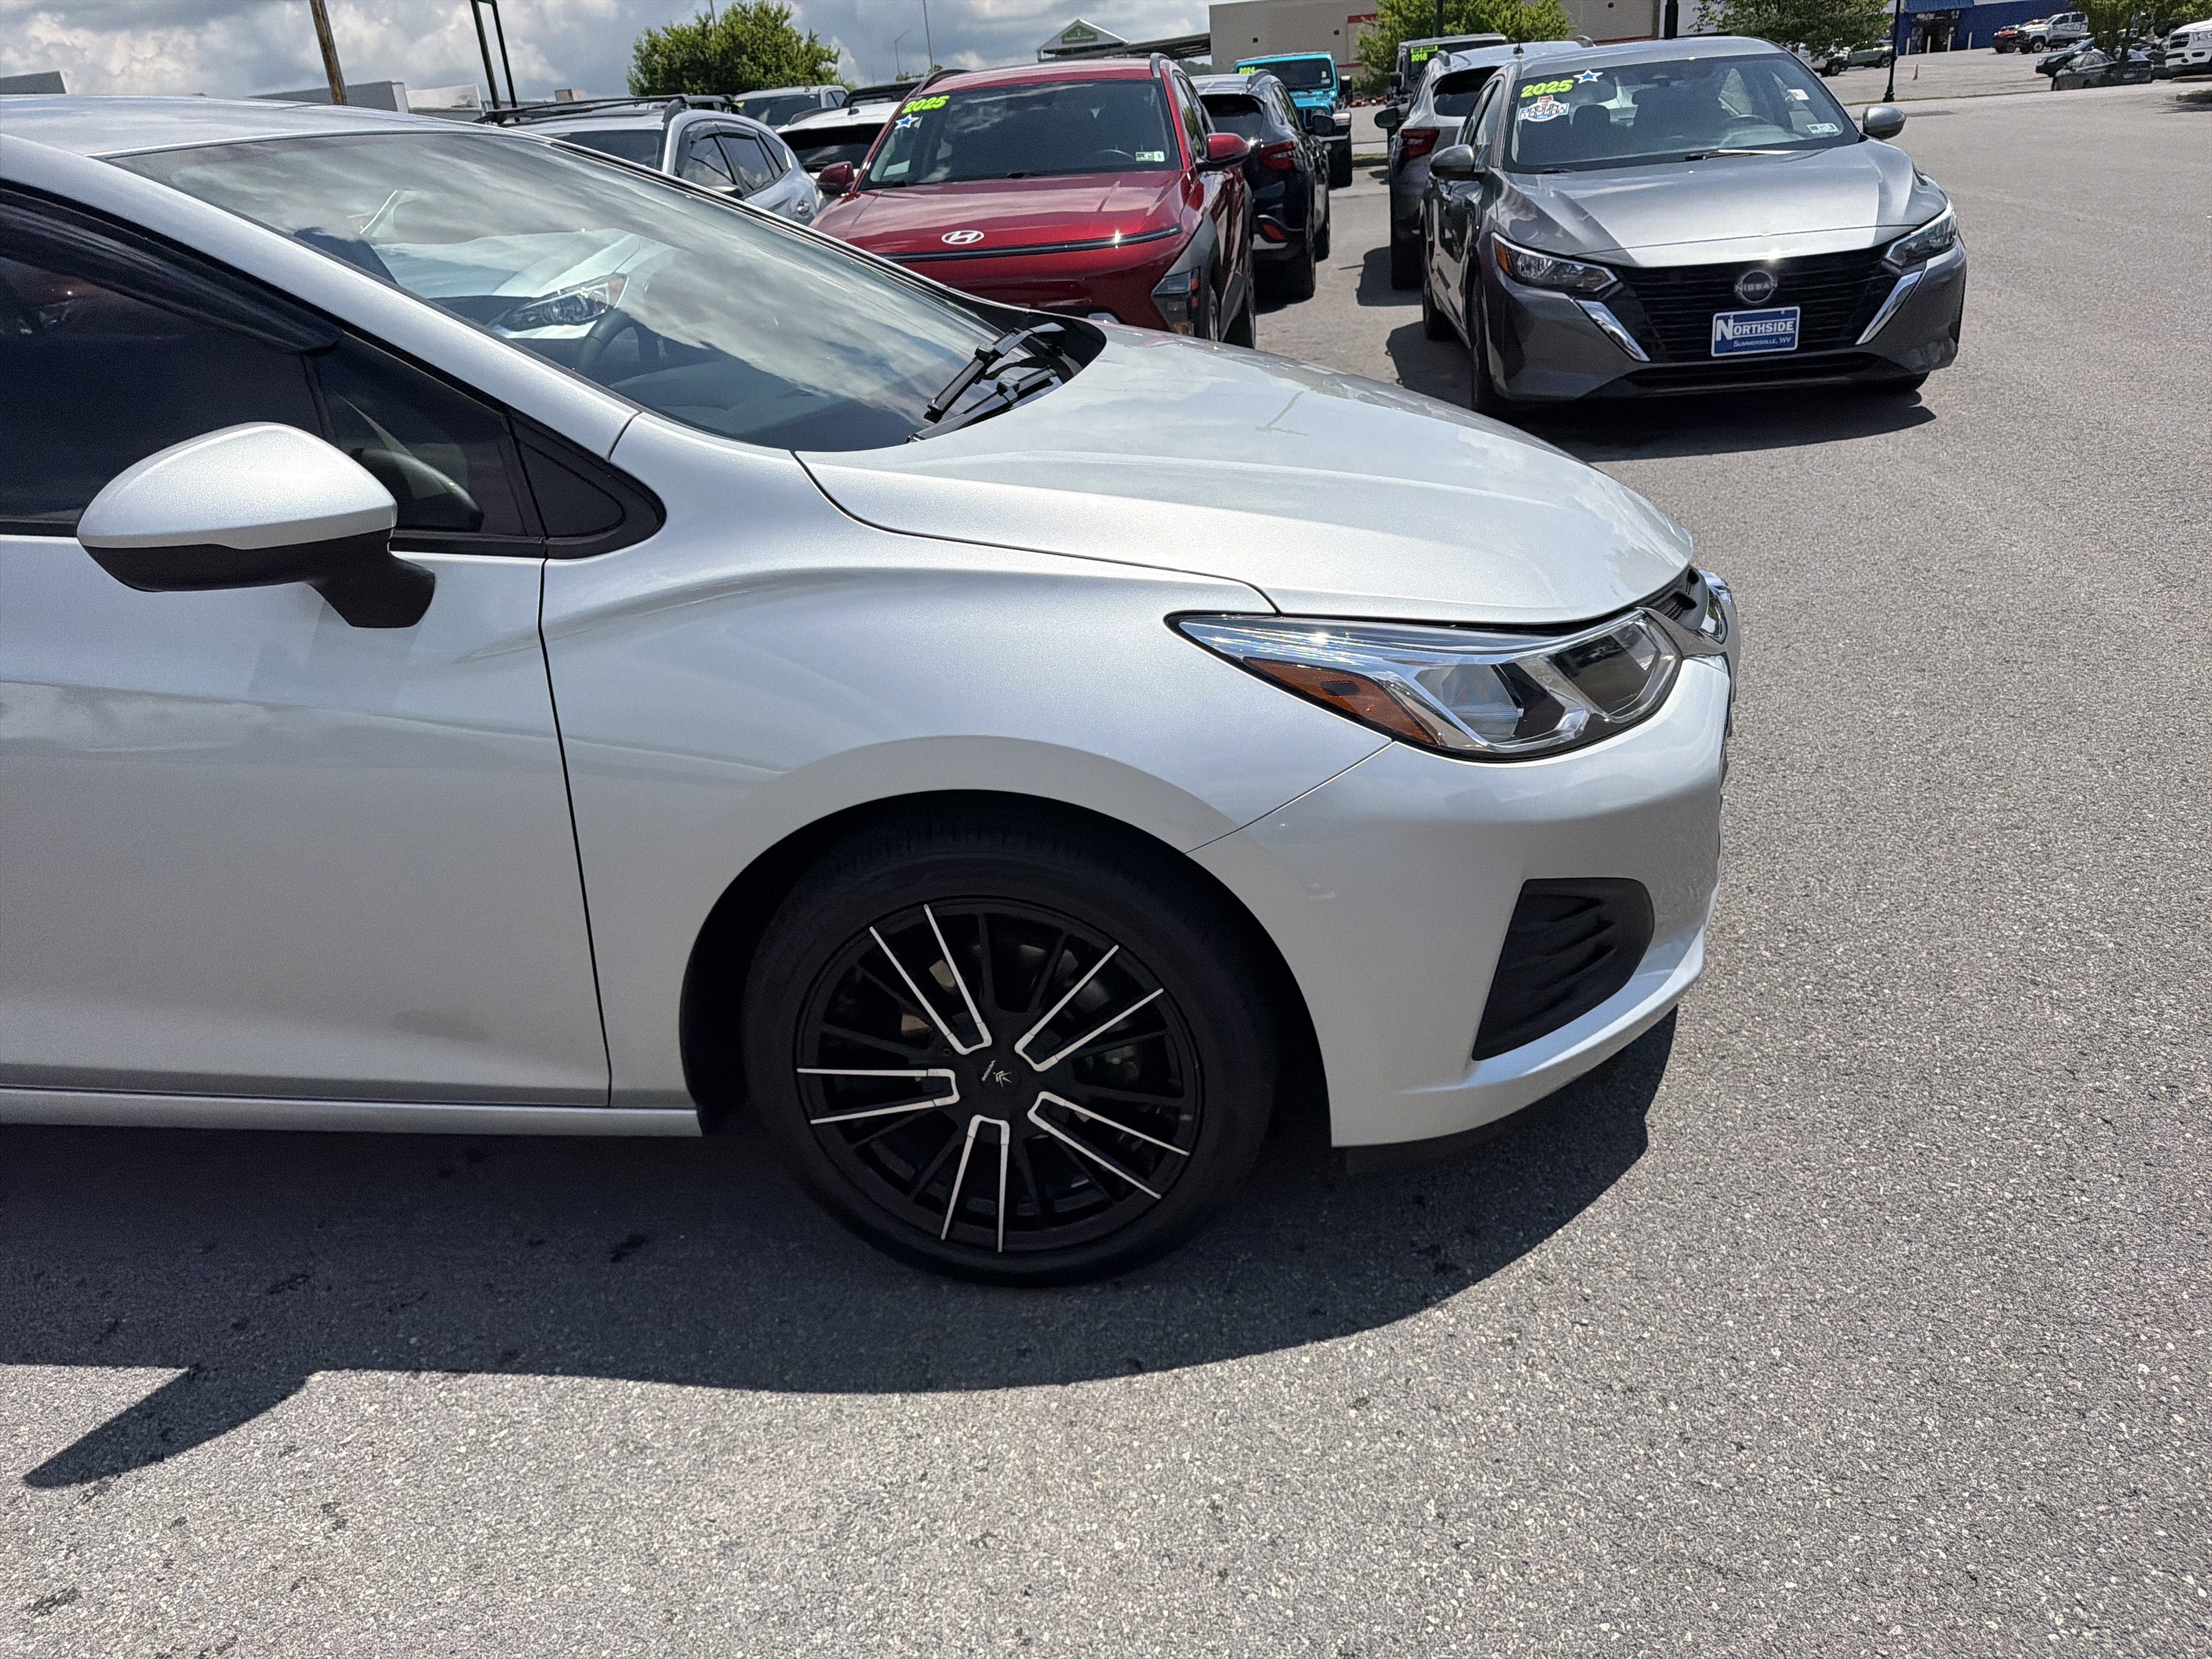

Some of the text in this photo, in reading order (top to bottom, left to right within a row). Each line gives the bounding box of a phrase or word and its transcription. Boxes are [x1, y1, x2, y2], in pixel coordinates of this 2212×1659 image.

[1520, 79, 1574, 98] 2025
[901, 95, 950, 114] 2025
[1735, 281, 1778, 292] NISSAN
[1716, 318, 1794, 341] NORTHSIDE
[1733, 338, 1778, 347] SUMMERSVILLE,
